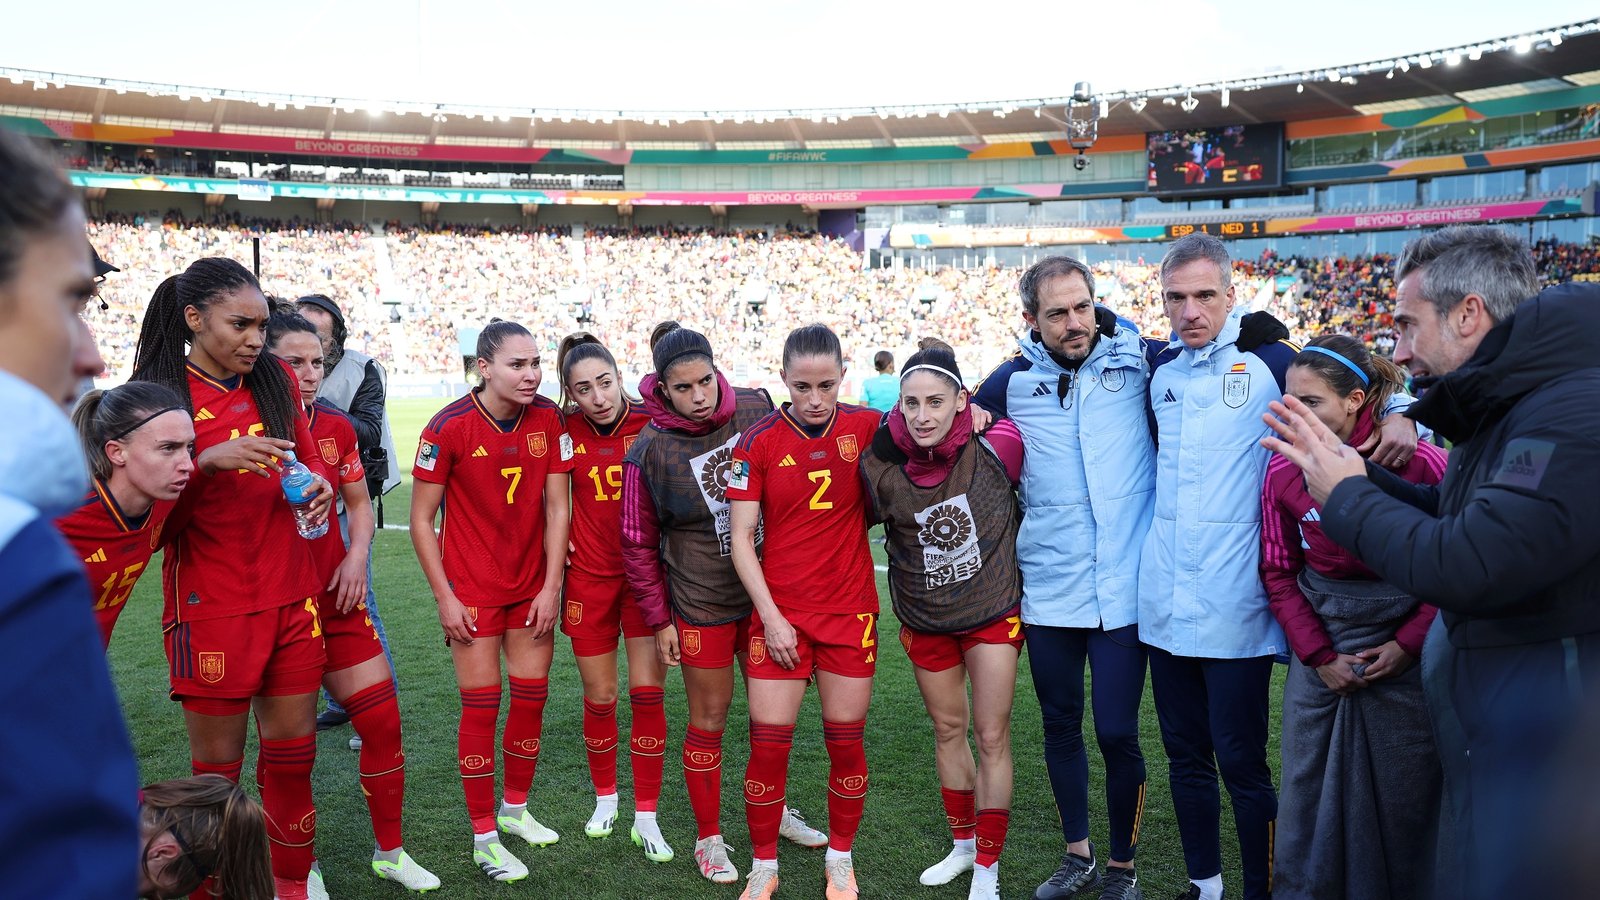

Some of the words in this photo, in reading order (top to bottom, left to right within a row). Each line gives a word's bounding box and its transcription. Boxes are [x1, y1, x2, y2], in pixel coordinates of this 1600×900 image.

[295, 140, 344, 152] BEYOND
[768, 151, 827, 161] #FIFAWWC
[747, 192, 791, 203] BEYOND
[1171, 225, 1193, 237] ESP
[1201, 225, 1208, 234] 1
[1221, 222, 1244, 235] NED
[1252, 222, 1260, 233] 1
[1355, 214, 1403, 227] BEYOND
[501, 467, 522, 504] 7
[588, 465, 623, 501] 19
[808, 469, 833, 510] 2
[95, 561, 144, 610] 15
[856, 613, 874, 648] 2
